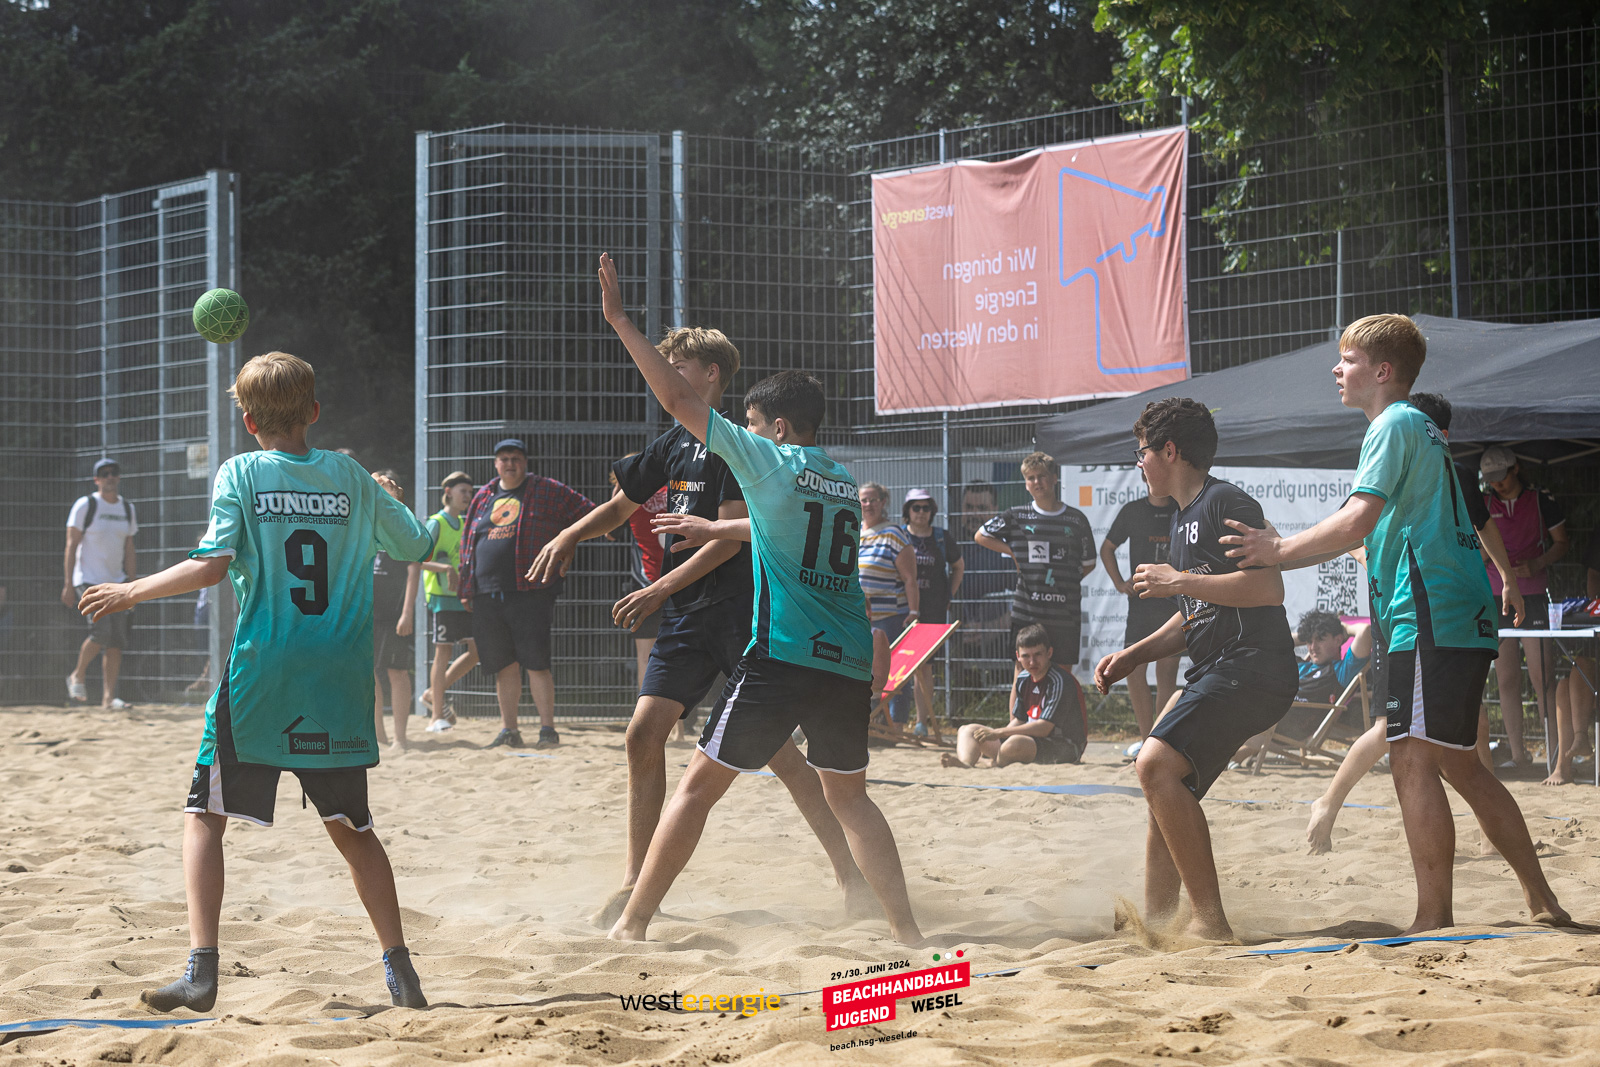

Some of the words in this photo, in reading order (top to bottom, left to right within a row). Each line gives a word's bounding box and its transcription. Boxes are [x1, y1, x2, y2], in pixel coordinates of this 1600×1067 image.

[693, 443, 708, 462] 14
[254, 490, 351, 519] JUNIORS
[801, 502, 859, 577] 16
[1185, 521, 1199, 545] 18
[284, 529, 329, 616] 9
[1041, 594, 1066, 603] LOTTO
[437, 625, 448, 641] 2
[816, 644, 841, 660] Stennes
[293, 737, 327, 751] Stennes
[331, 736, 369, 750] Immobilien
